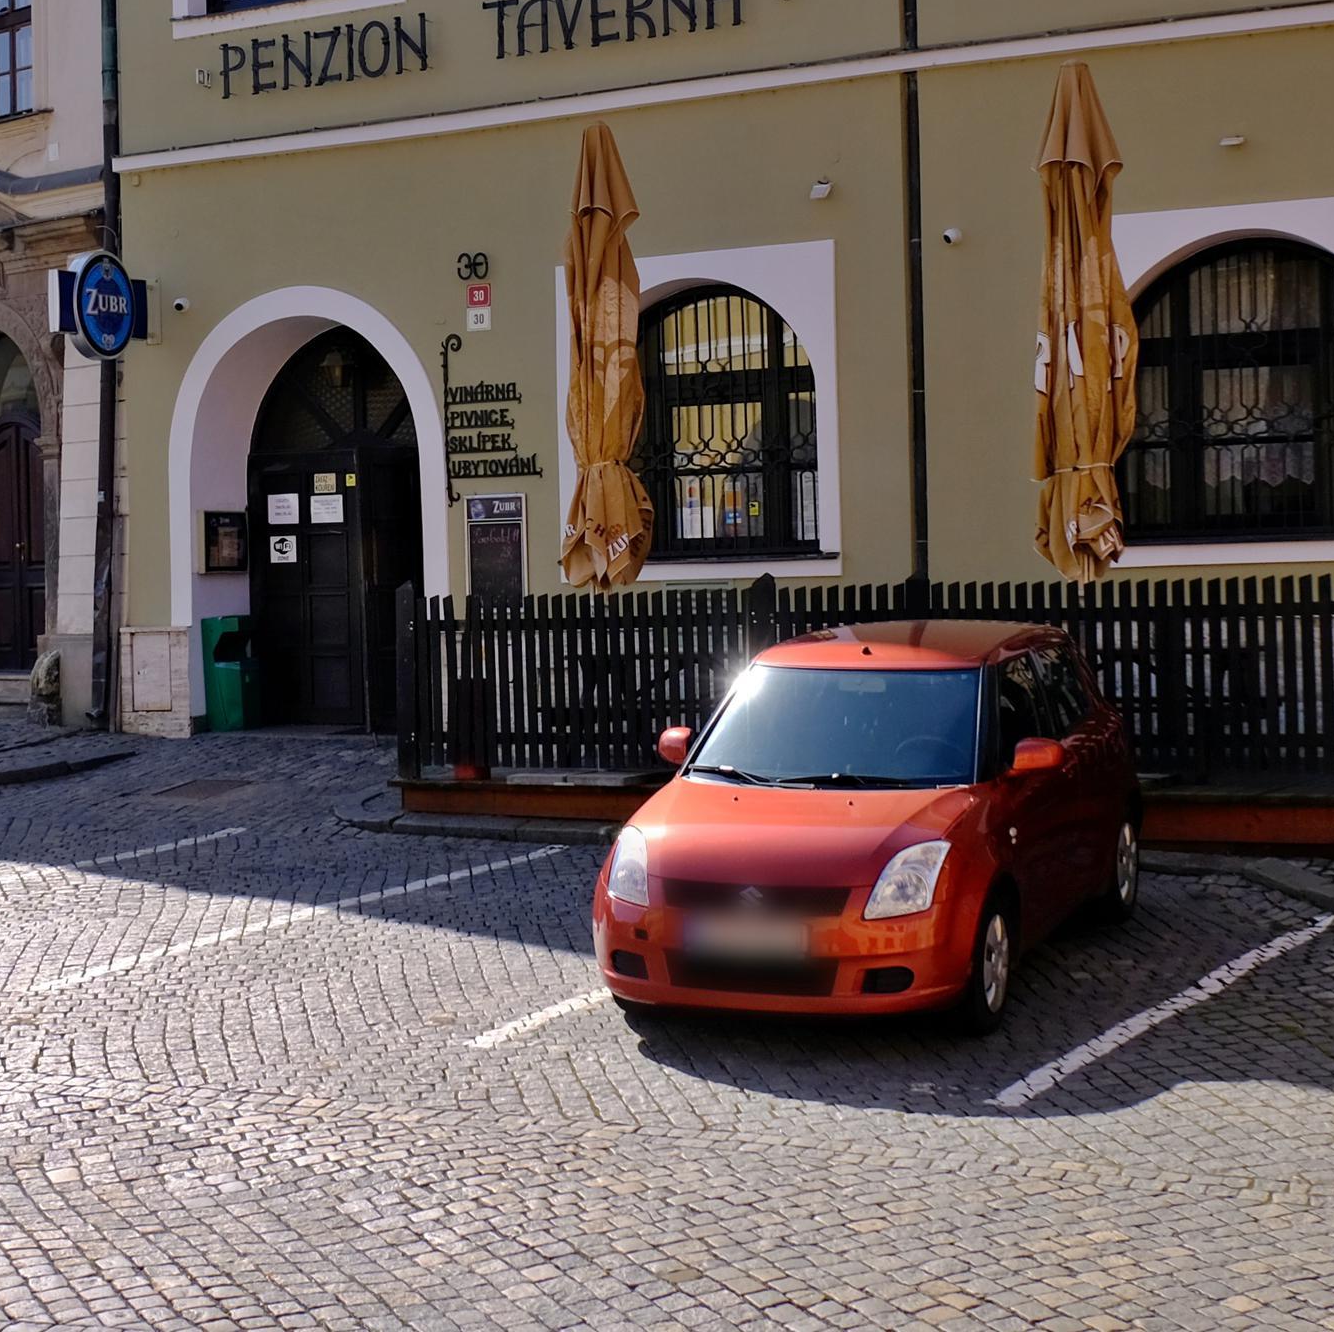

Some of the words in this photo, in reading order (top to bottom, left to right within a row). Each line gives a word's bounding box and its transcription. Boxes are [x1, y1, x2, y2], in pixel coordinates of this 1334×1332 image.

[219, 12, 432, 99] PENZION
[457, 252, 488, 280] 30
[473, 290, 485, 301] 30
[473, 313, 485, 324] 30
